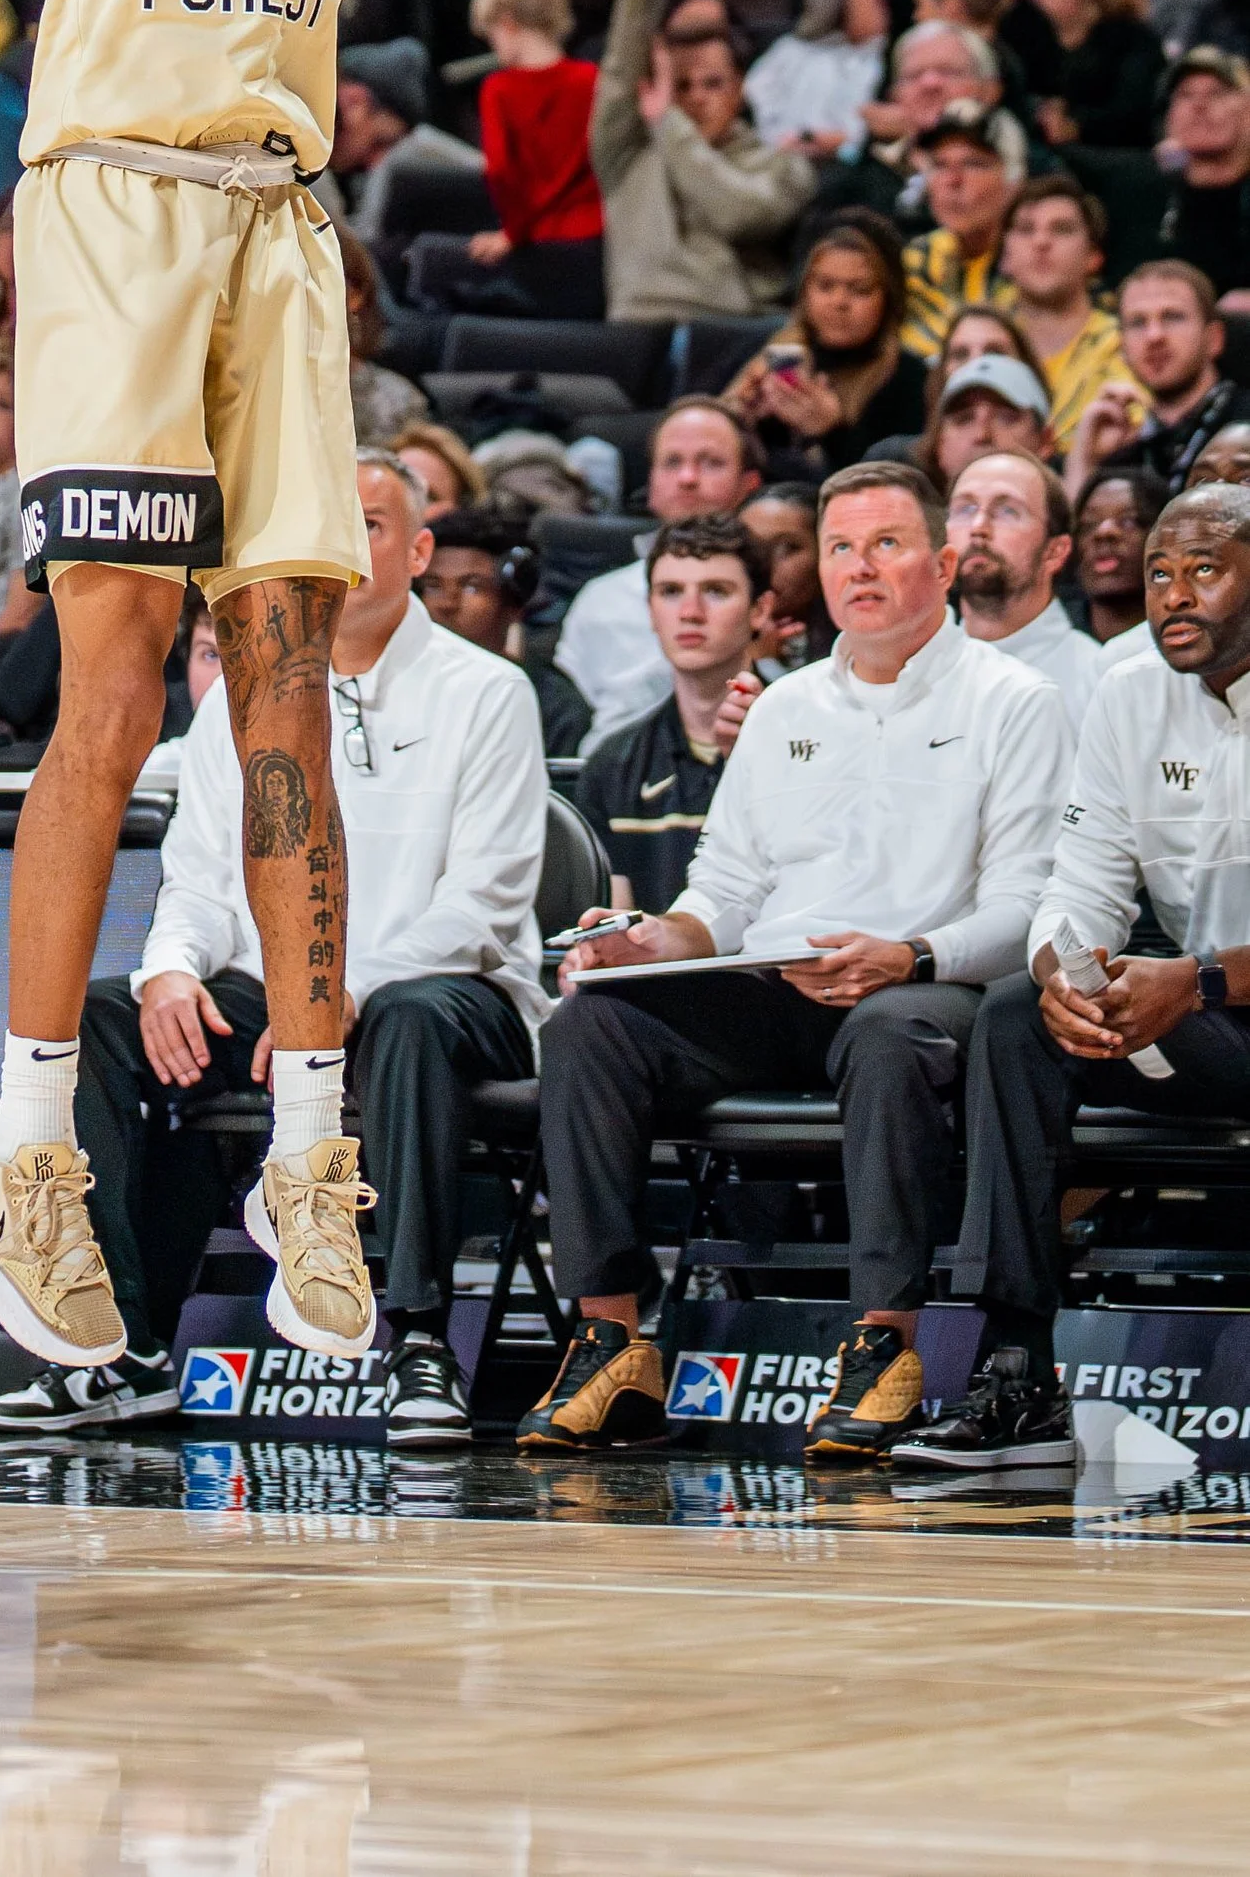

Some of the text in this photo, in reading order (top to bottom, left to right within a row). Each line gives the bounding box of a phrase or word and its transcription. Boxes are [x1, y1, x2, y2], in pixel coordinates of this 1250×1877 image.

[61, 487, 197, 543] DEMON
[1160, 761, 1200, 791] WF
[259, 1349, 383, 1381] FIRST
[750, 1353, 840, 1388] FIRS
[1073, 1363, 1202, 1400] FIRST
[250, 1385, 388, 1417] HORIZ
